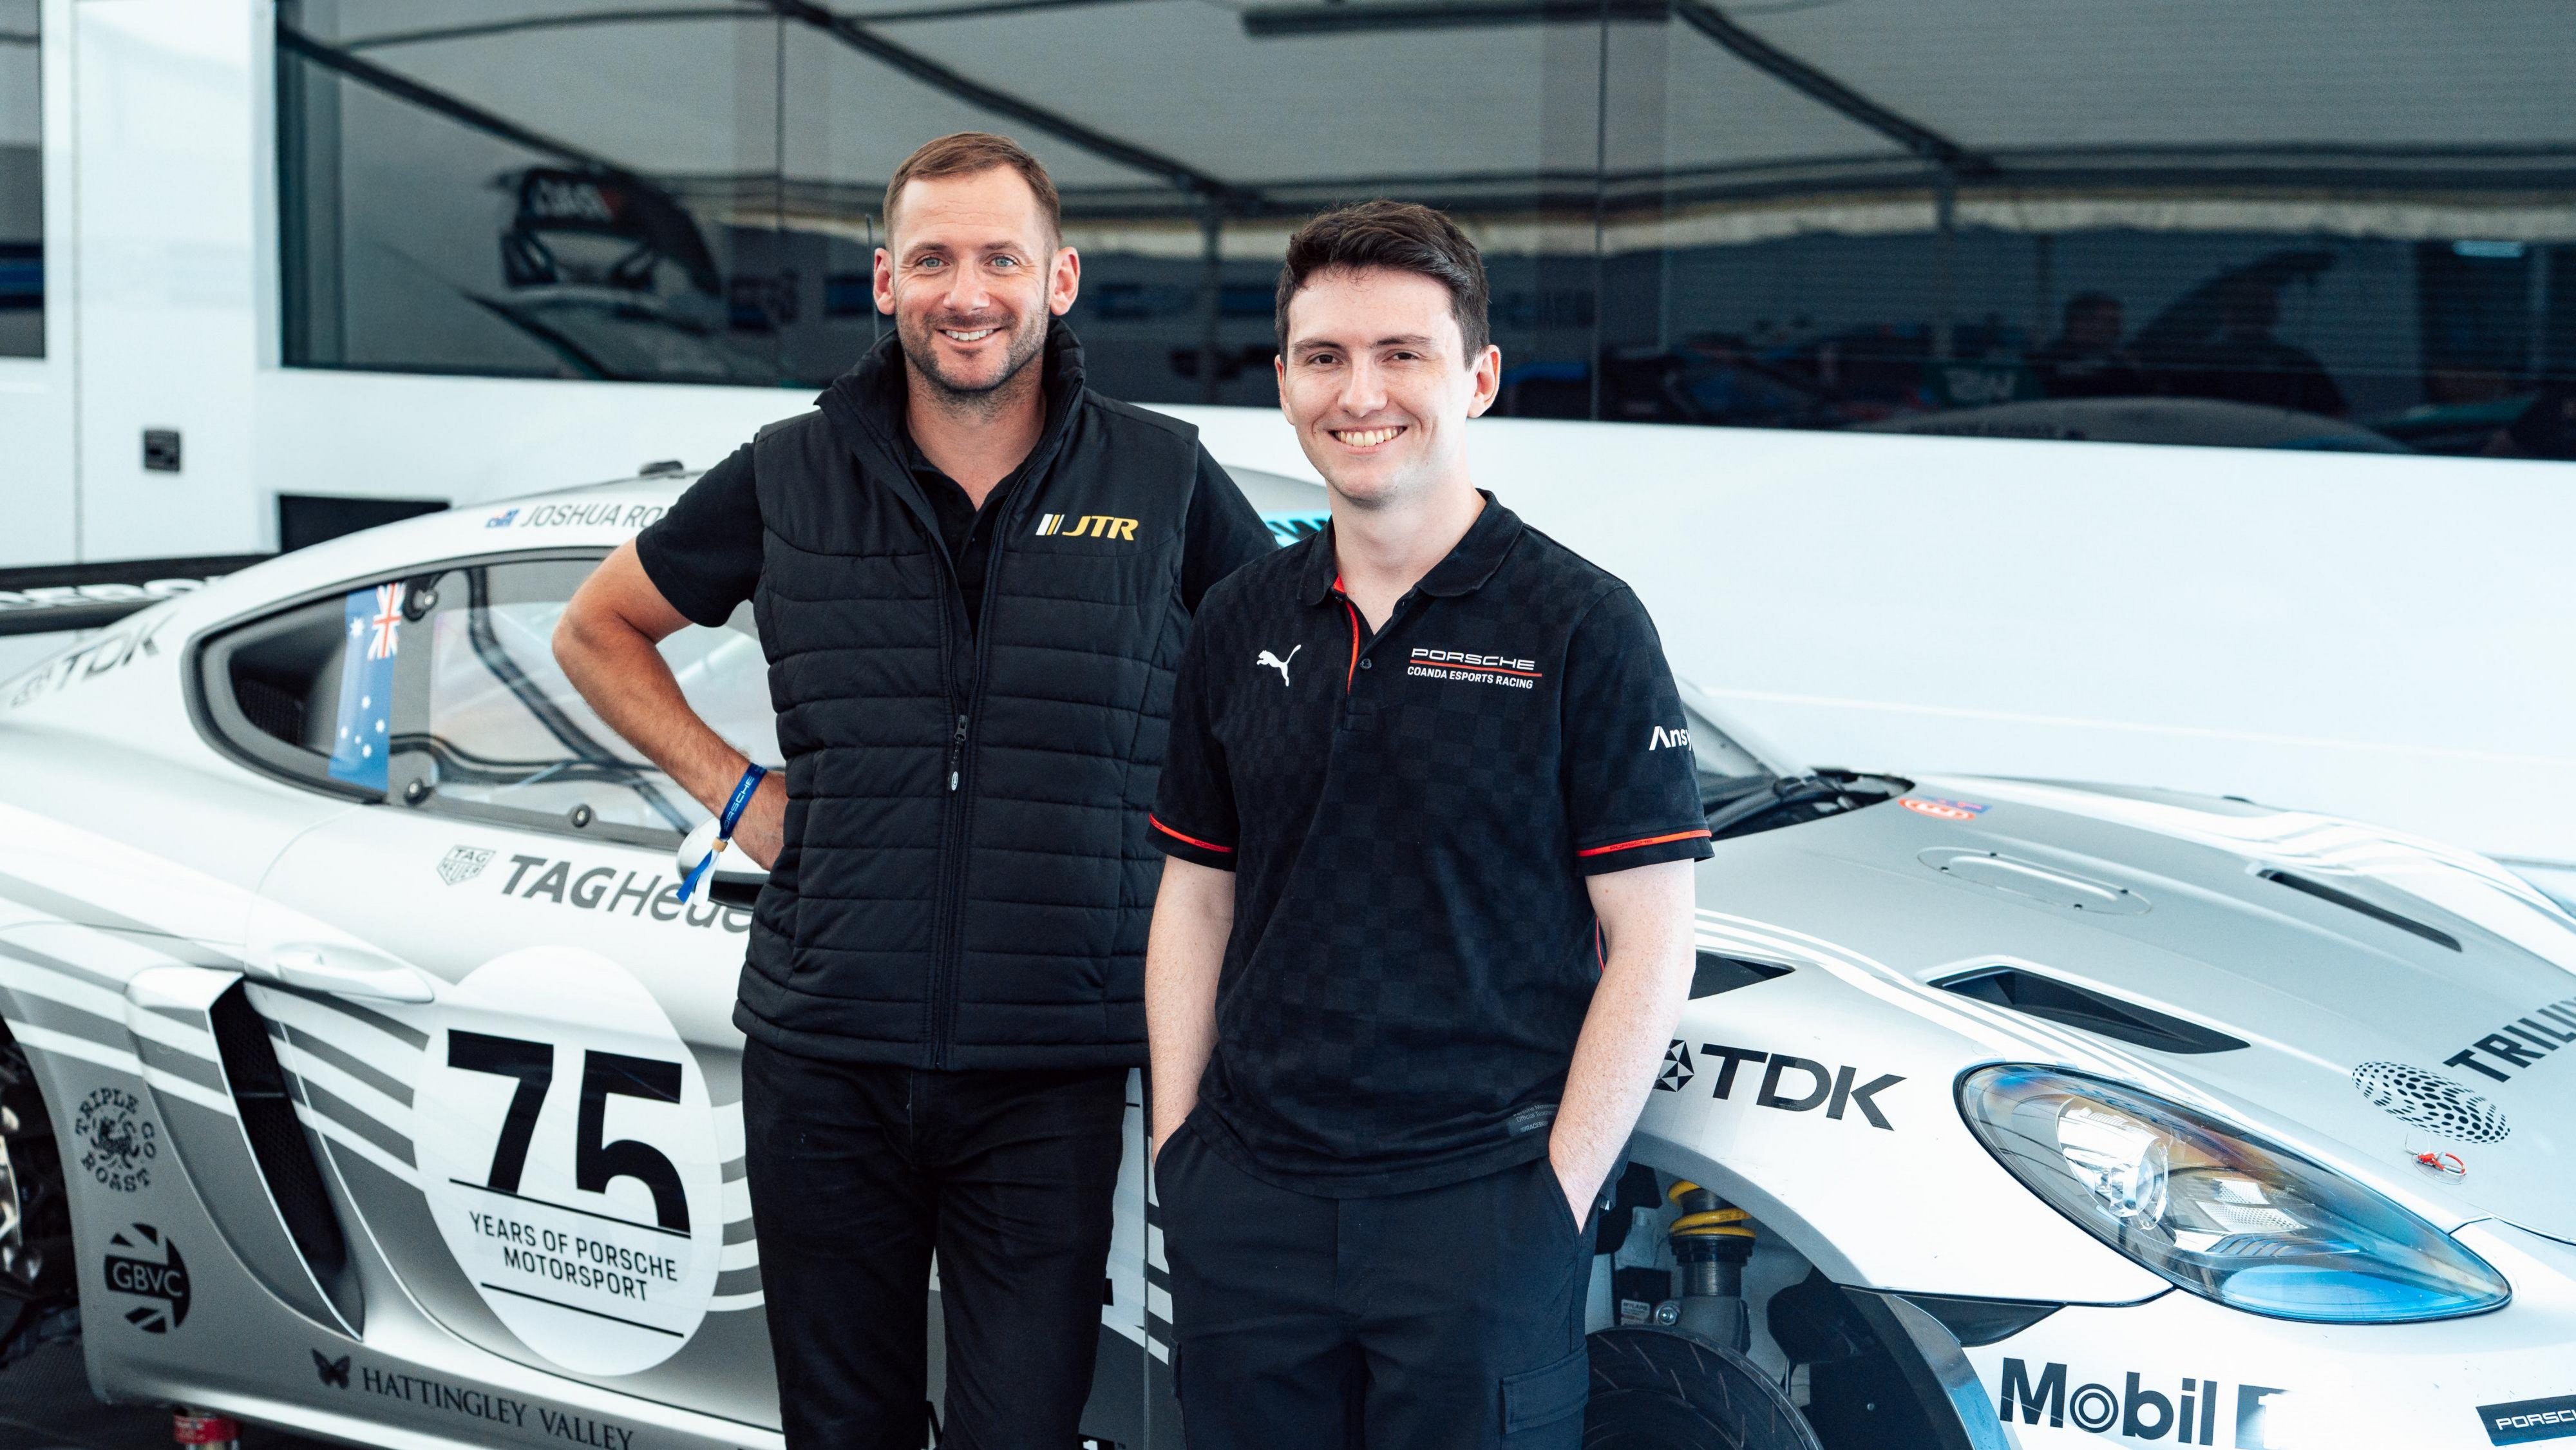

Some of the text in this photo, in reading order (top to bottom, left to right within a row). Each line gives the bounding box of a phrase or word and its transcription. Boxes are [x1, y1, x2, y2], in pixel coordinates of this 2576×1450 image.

[520, 504, 622, 528] JOSHUA
[1062, 515, 1139, 541] JTR
[1406, 666, 1533, 689] COANDA ESPORTS RACING
[1411, 648, 1535, 671] PORSCHE
[724, 775, 755, 831] ORSCHE
[454, 848, 489, 863] TAG
[1610, 839, 1653, 850] PORSCHE
[1700, 1043, 1908, 1132] TDK
[75, 1087, 140, 1136] TRIPLE
[448, 1028, 691, 1235] 75
[1516, 1112, 1535, 1122] Official
[80, 1151, 152, 1192] ROAST
[469, 1210, 678, 1282] YEARS OF PORSCHE
[112, 1261, 184, 1297] GBVC
[503, 1246, 648, 1302] MOTORSPORT
[362, 1367, 634, 1450] HATTINGLEY VALLEY
[2000, 1357, 2218, 1446] Mobil
